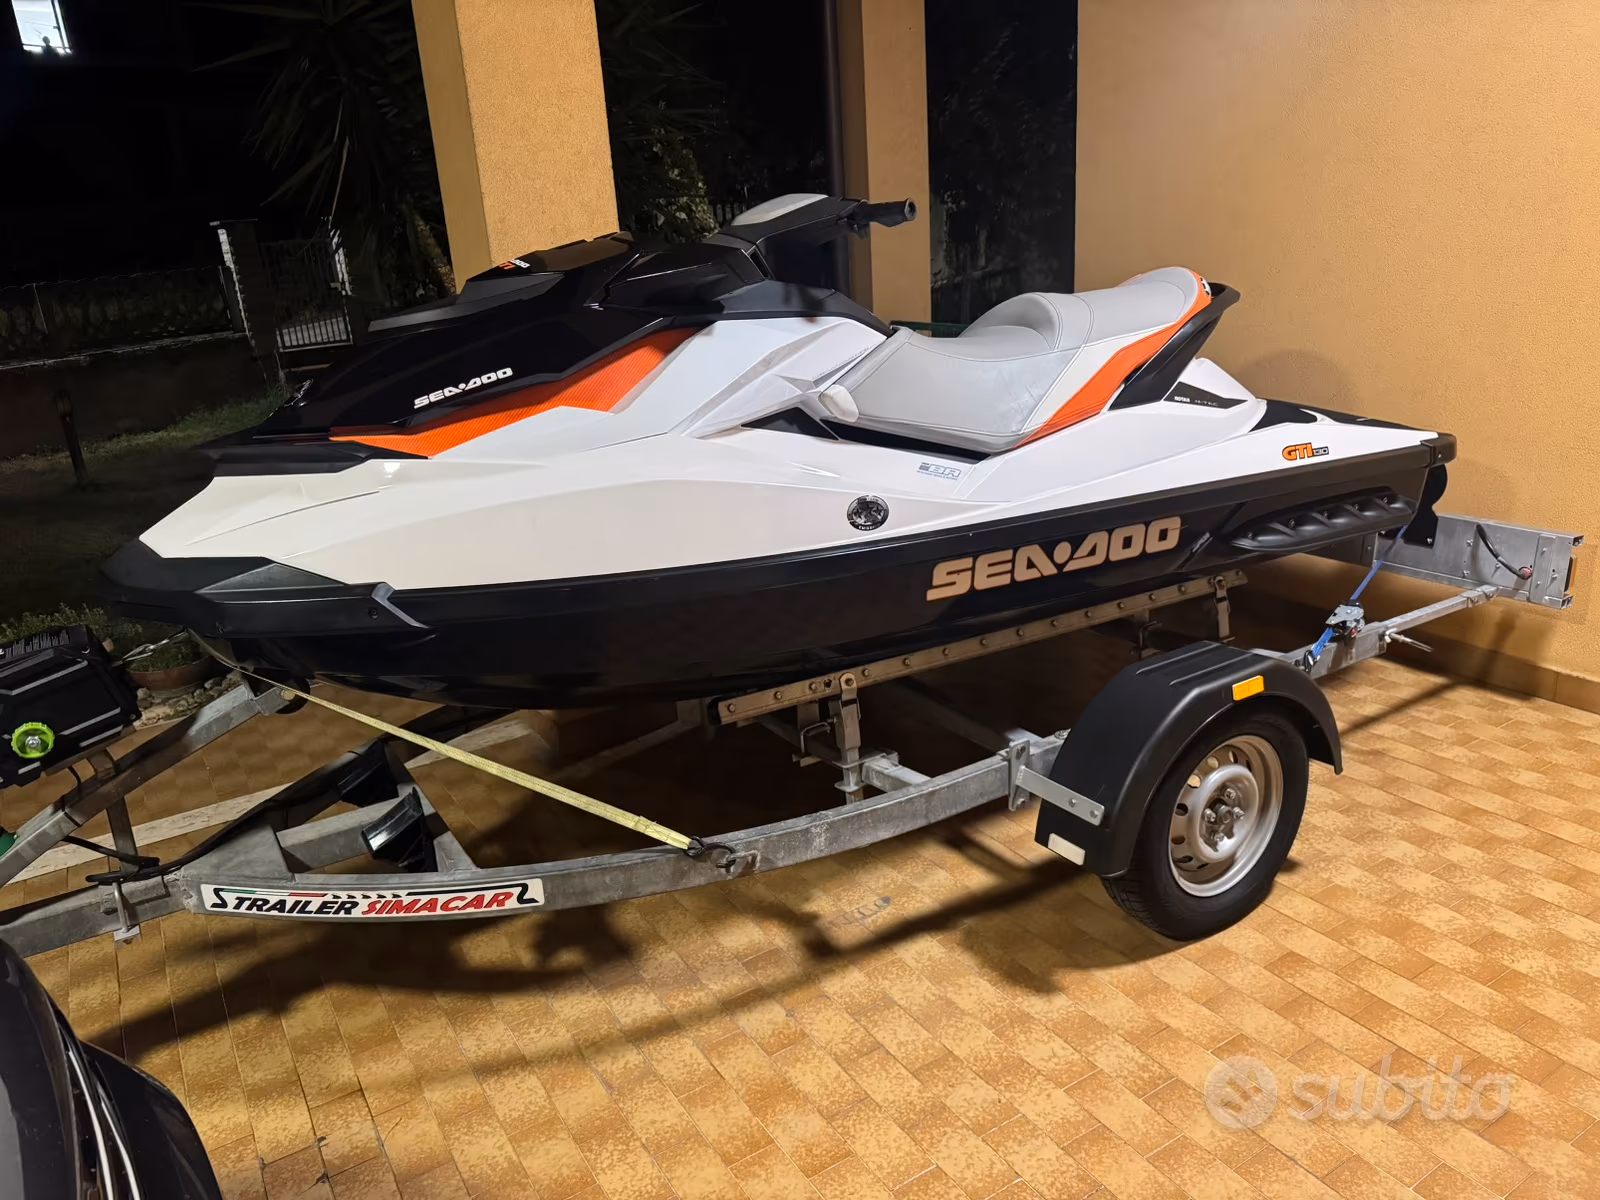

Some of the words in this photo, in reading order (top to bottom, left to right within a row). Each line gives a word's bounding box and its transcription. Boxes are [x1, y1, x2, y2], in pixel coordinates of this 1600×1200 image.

[1282, 442, 1312, 460] GTI
[232, 896, 360, 915] TRAILER
[361, 891, 514, 915] SIMACAR
